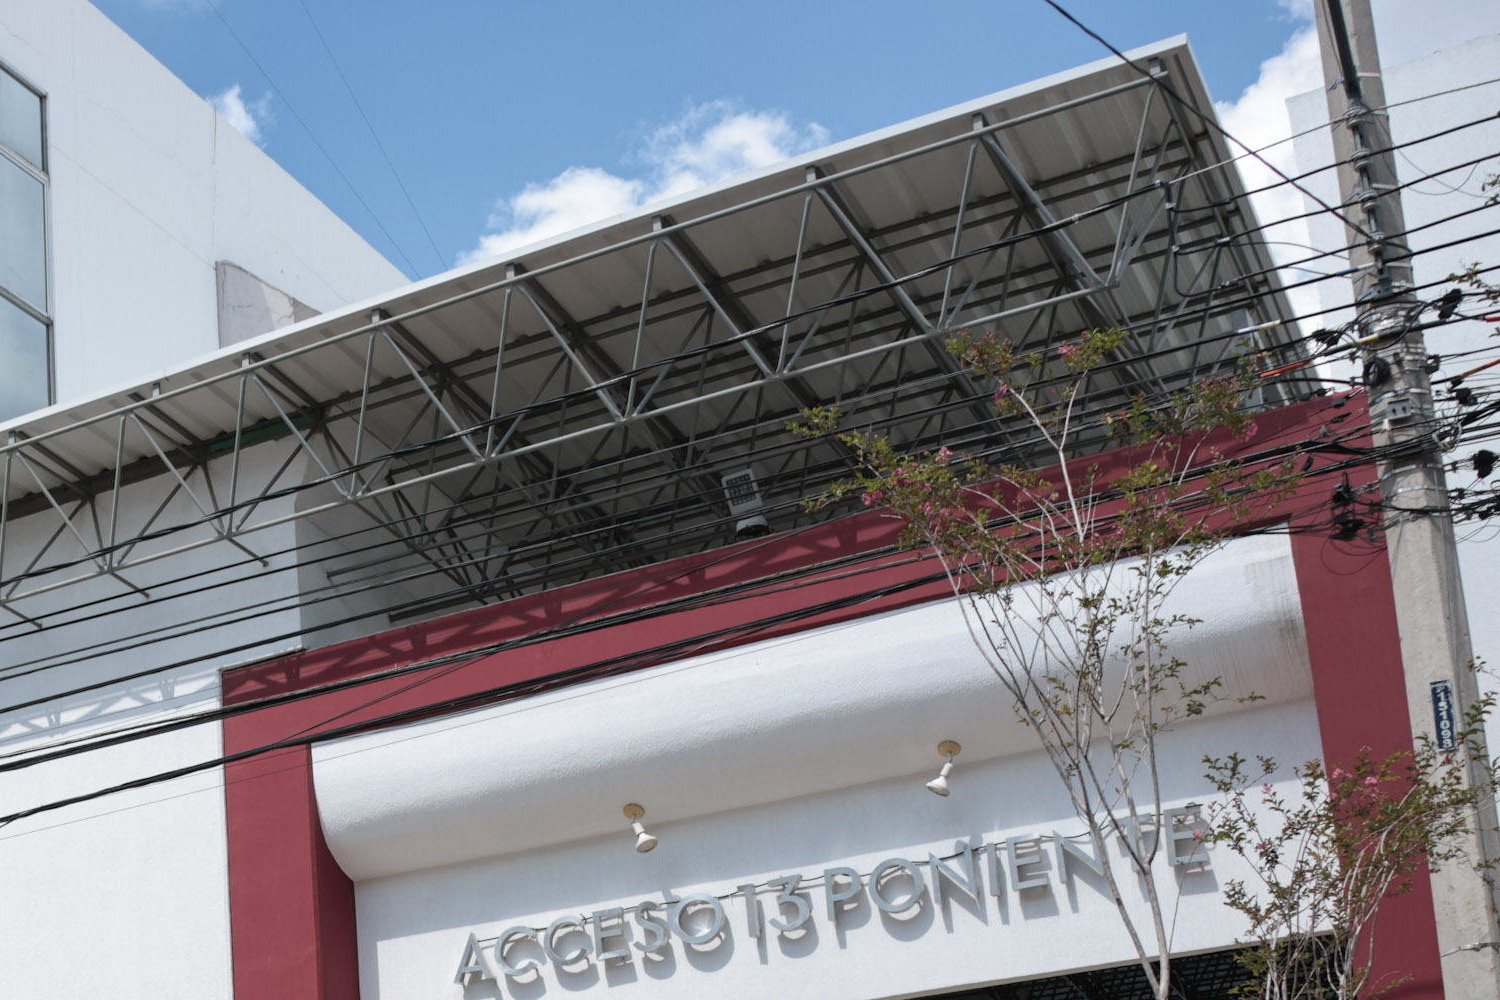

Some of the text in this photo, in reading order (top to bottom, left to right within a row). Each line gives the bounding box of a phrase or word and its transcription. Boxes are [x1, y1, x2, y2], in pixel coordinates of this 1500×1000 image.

[453, 805, 1211, 985] ACCESO 13 PONIENTE
